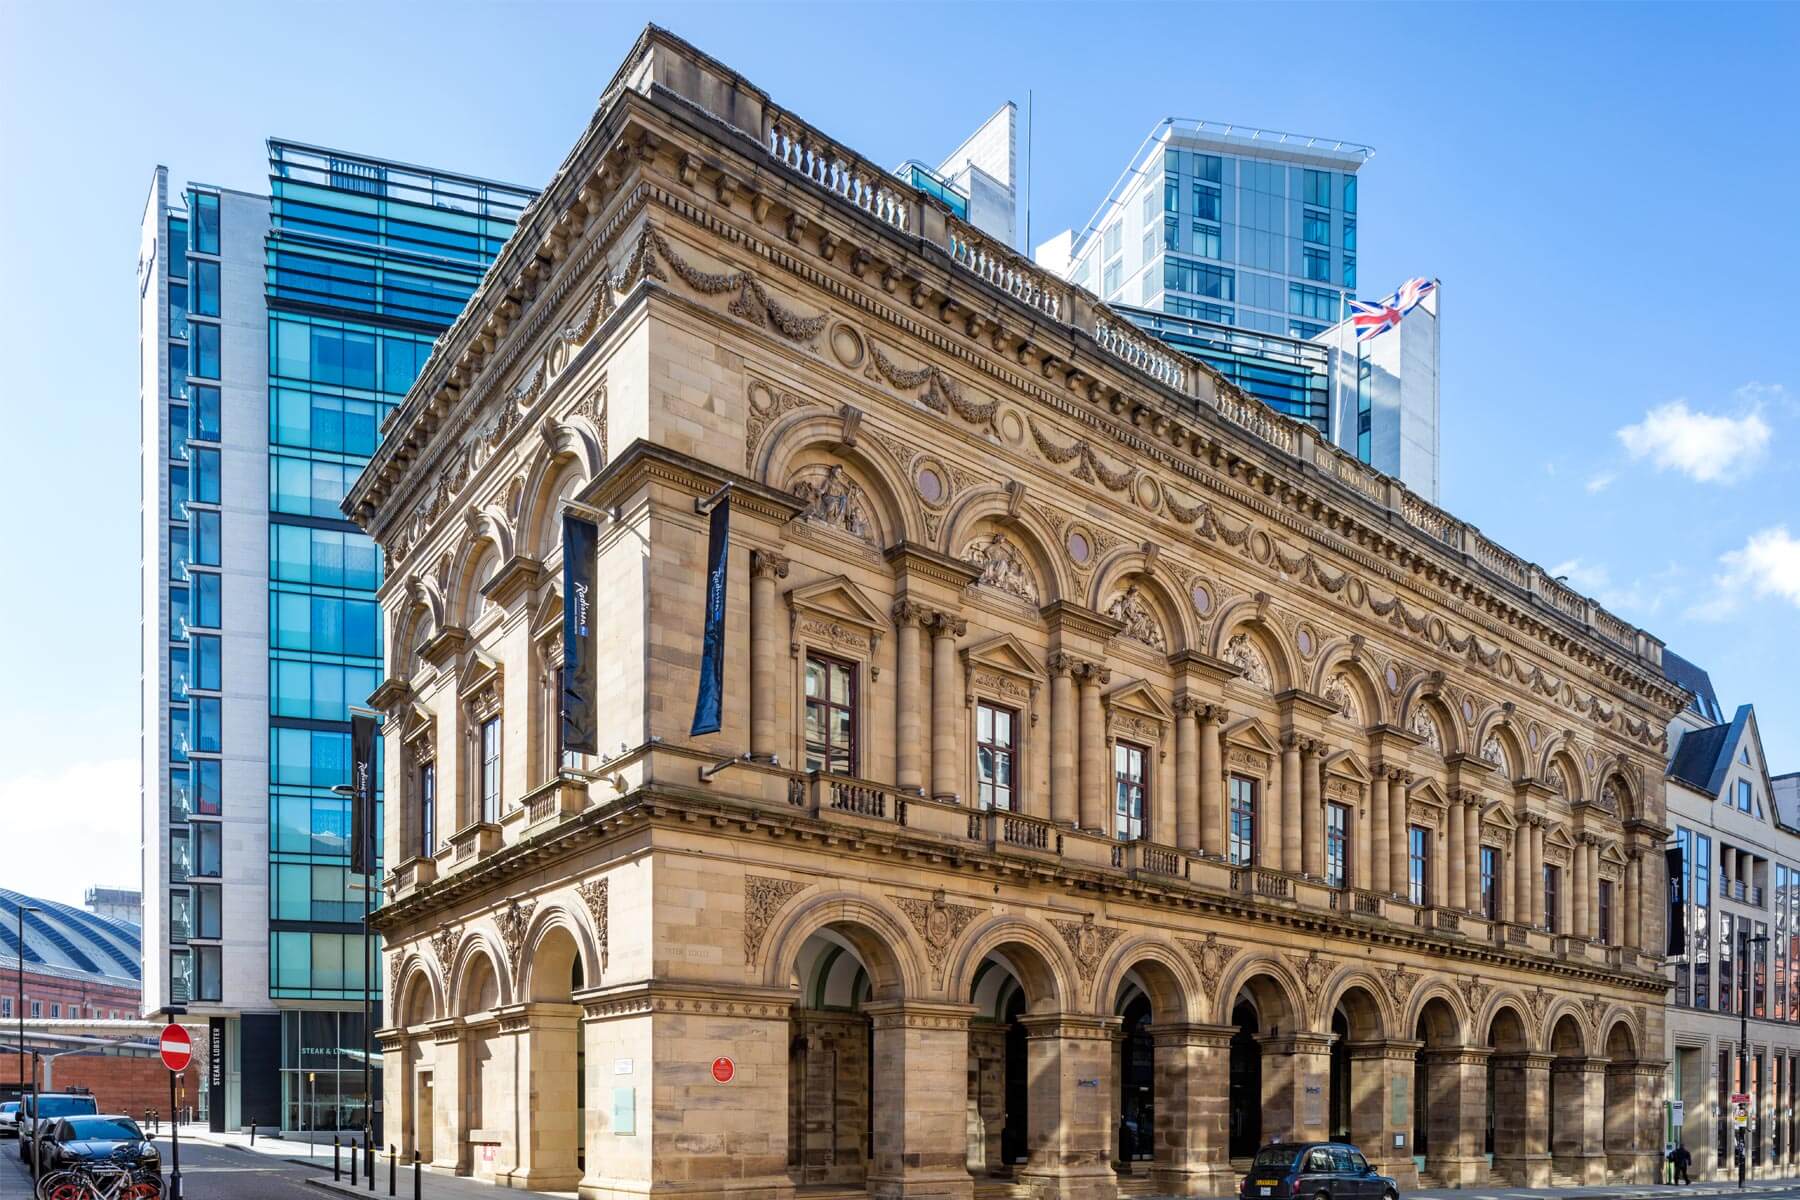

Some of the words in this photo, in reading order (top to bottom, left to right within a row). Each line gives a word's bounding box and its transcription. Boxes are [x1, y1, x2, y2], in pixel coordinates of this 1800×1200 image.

[574, 581, 590, 625] Radisson
[212, 1028, 220, 1056] LOBSTER
[301, 1047, 325, 1055] STEAK
[212, 1065, 220, 1086] STEAK
